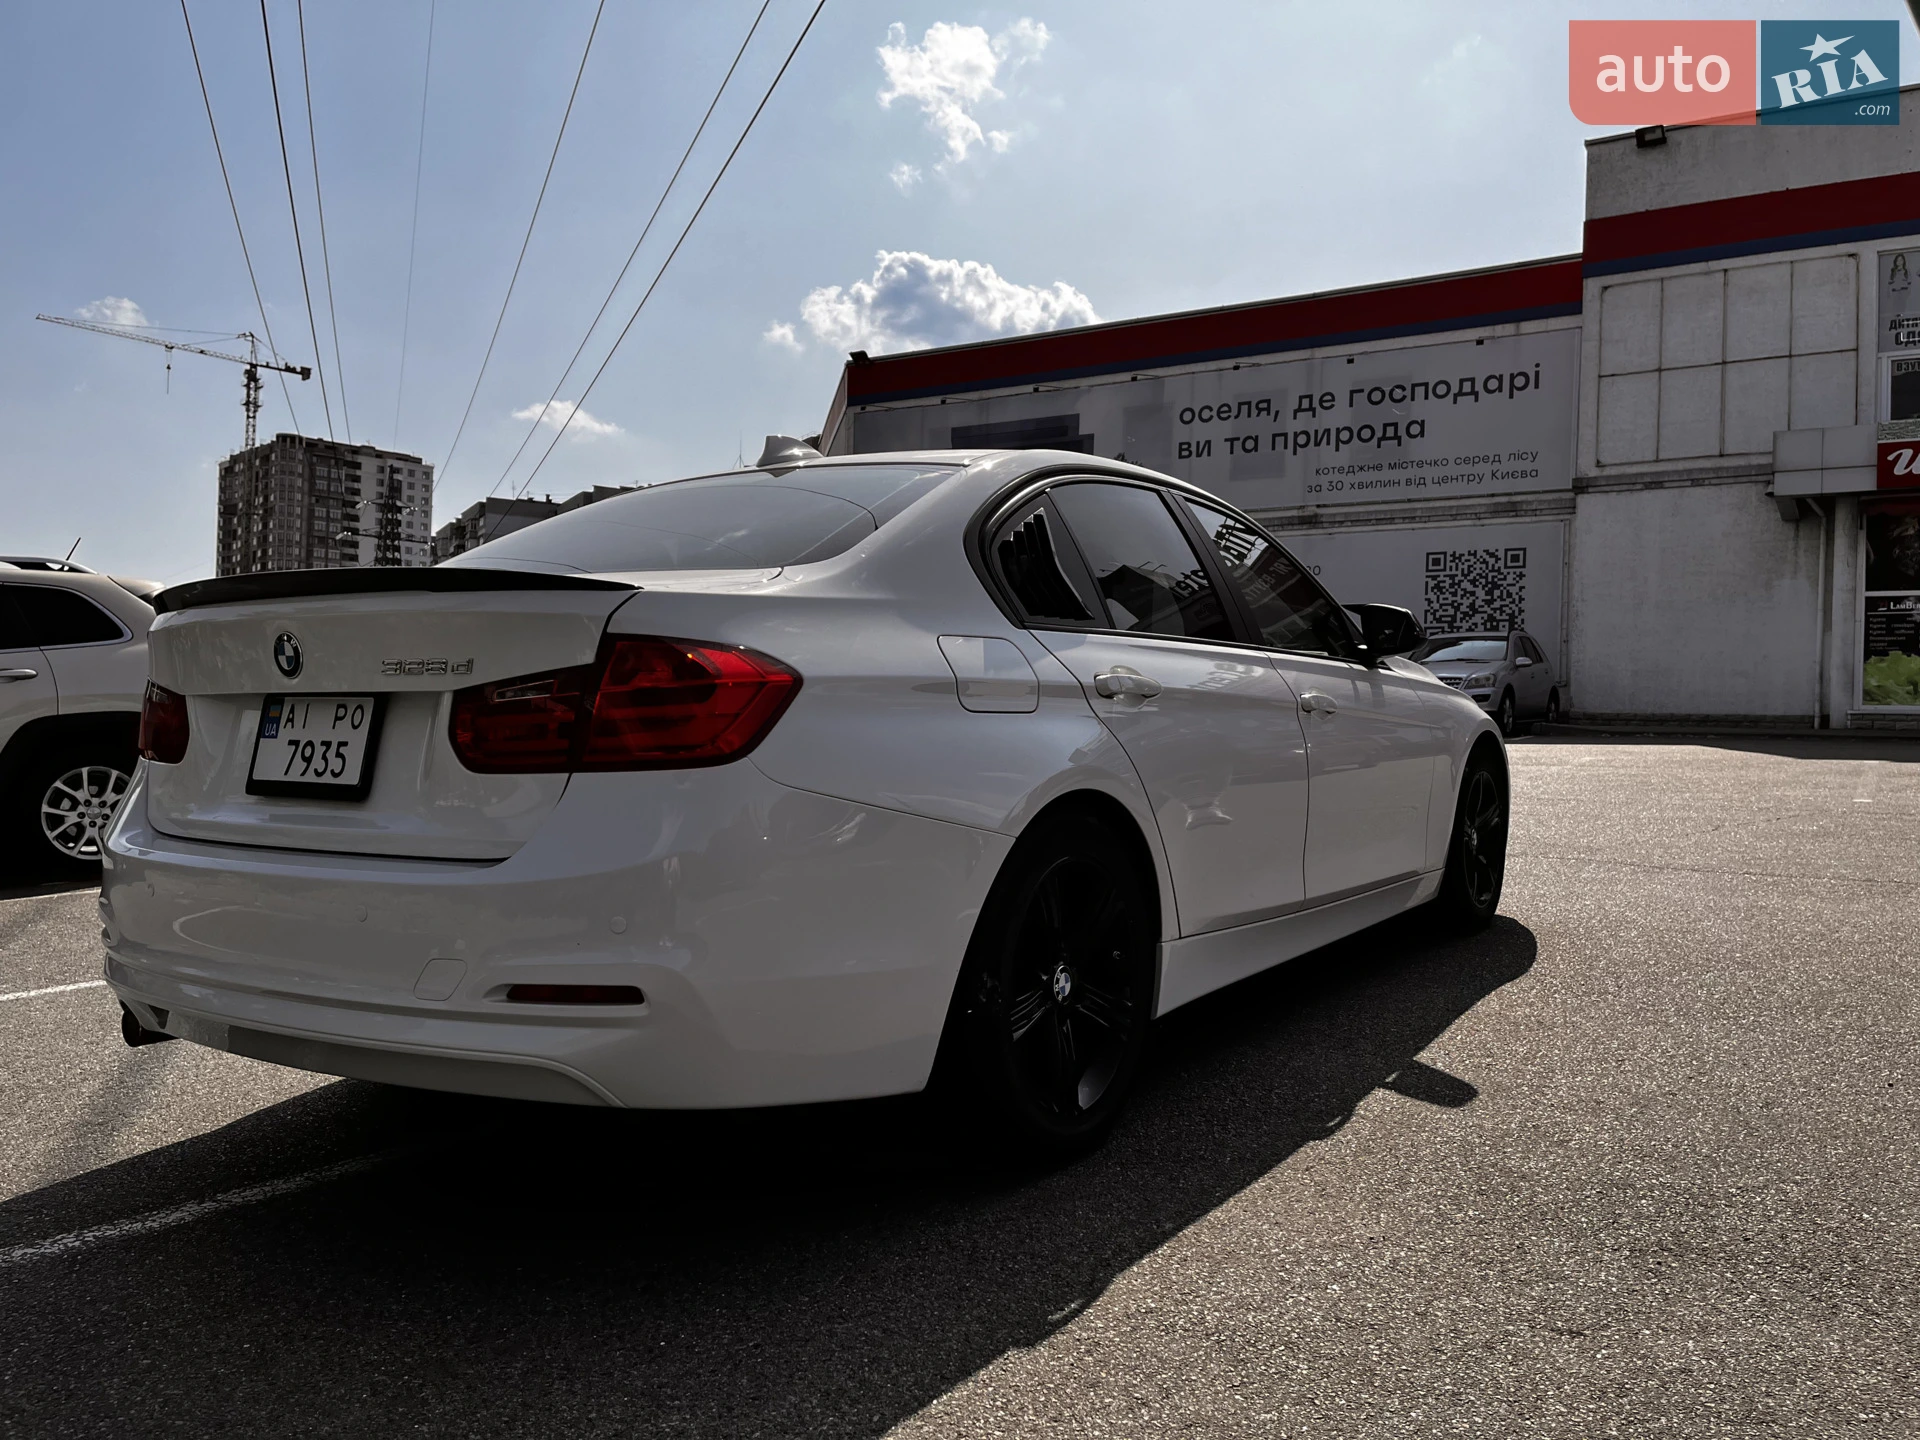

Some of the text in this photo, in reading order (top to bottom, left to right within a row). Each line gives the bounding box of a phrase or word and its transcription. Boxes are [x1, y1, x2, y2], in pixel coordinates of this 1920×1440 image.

[1179, 363, 1542, 425] оселя, де господарі
[1177, 418, 1426, 460] ви та природа
[1315, 449, 1539, 476] котеджне містечко серед лісу
[1306, 467, 1539, 494] за 30 хвилин від центру Києва
[264, 723, 277, 737] UA
[283, 703, 365, 730] AI PO
[283, 740, 349, 778] 7935
